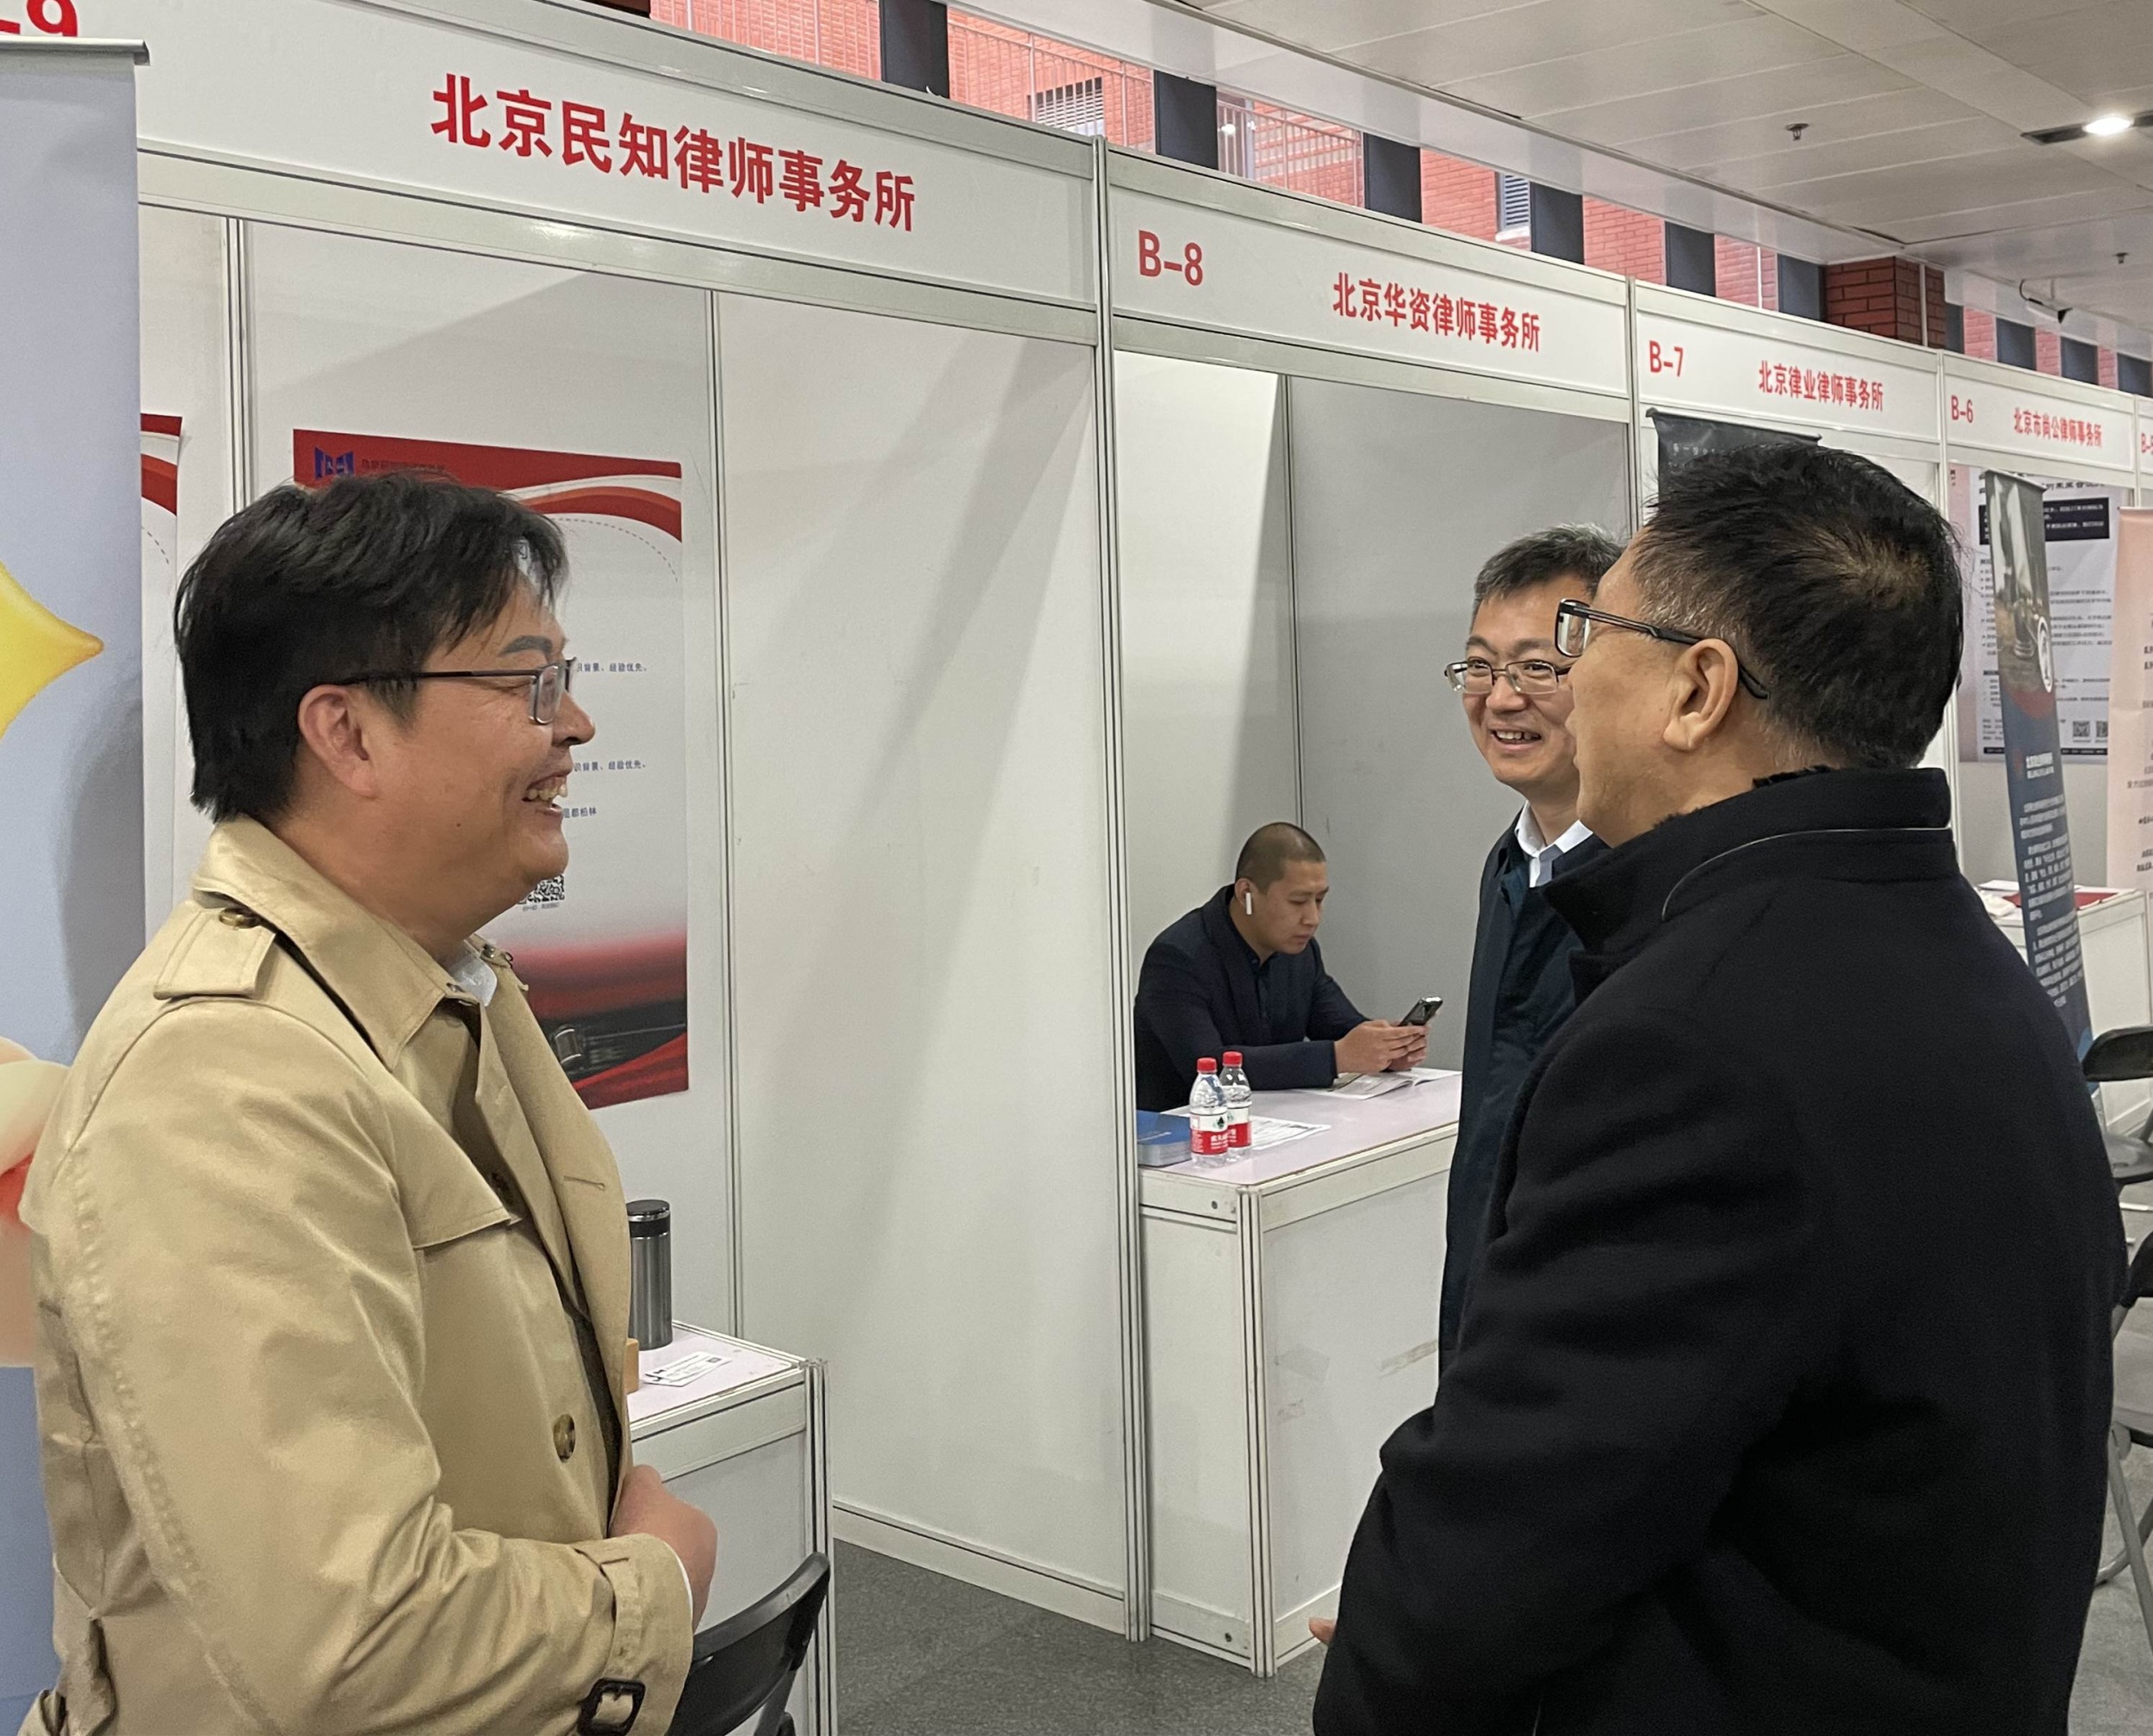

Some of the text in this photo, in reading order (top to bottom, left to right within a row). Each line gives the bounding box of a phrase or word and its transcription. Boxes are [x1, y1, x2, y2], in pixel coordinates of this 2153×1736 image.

[431, 73, 915, 232] 北京民知律师事务所
[1139, 230, 1203, 286] B-8
[1332, 272, 1541, 352] 北京华资律师事务所
[1649, 340, 1684, 376] B-7
[1759, 360, 1883, 412] 北京律业律师事务所
[1951, 394, 1974, 423] B-6
